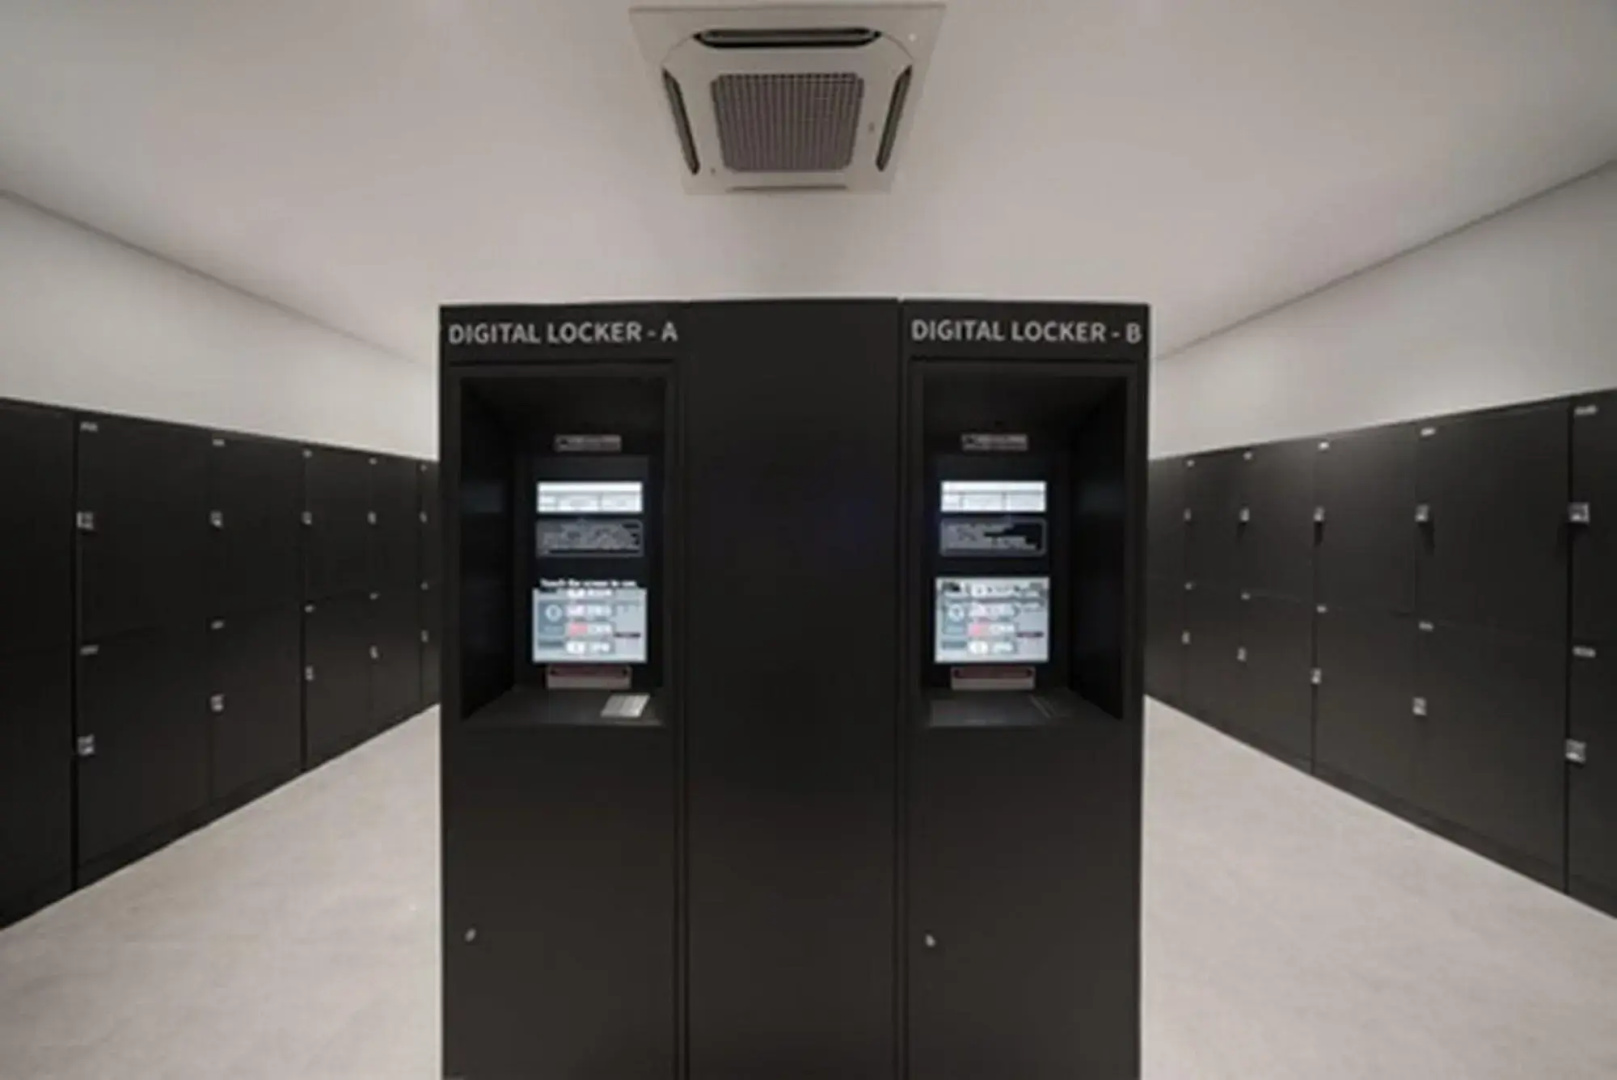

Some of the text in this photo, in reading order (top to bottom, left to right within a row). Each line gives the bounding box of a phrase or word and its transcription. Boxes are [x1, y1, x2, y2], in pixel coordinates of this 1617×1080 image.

[449, 322, 540, 344] DIGITAL
[547, 321, 642, 343] LOCKER
[661, 321, 678, 342] A
[911, 319, 1005, 341] DIGITAL
[1011, 320, 1106, 343] LOCKER
[1126, 322, 1142, 343] B
